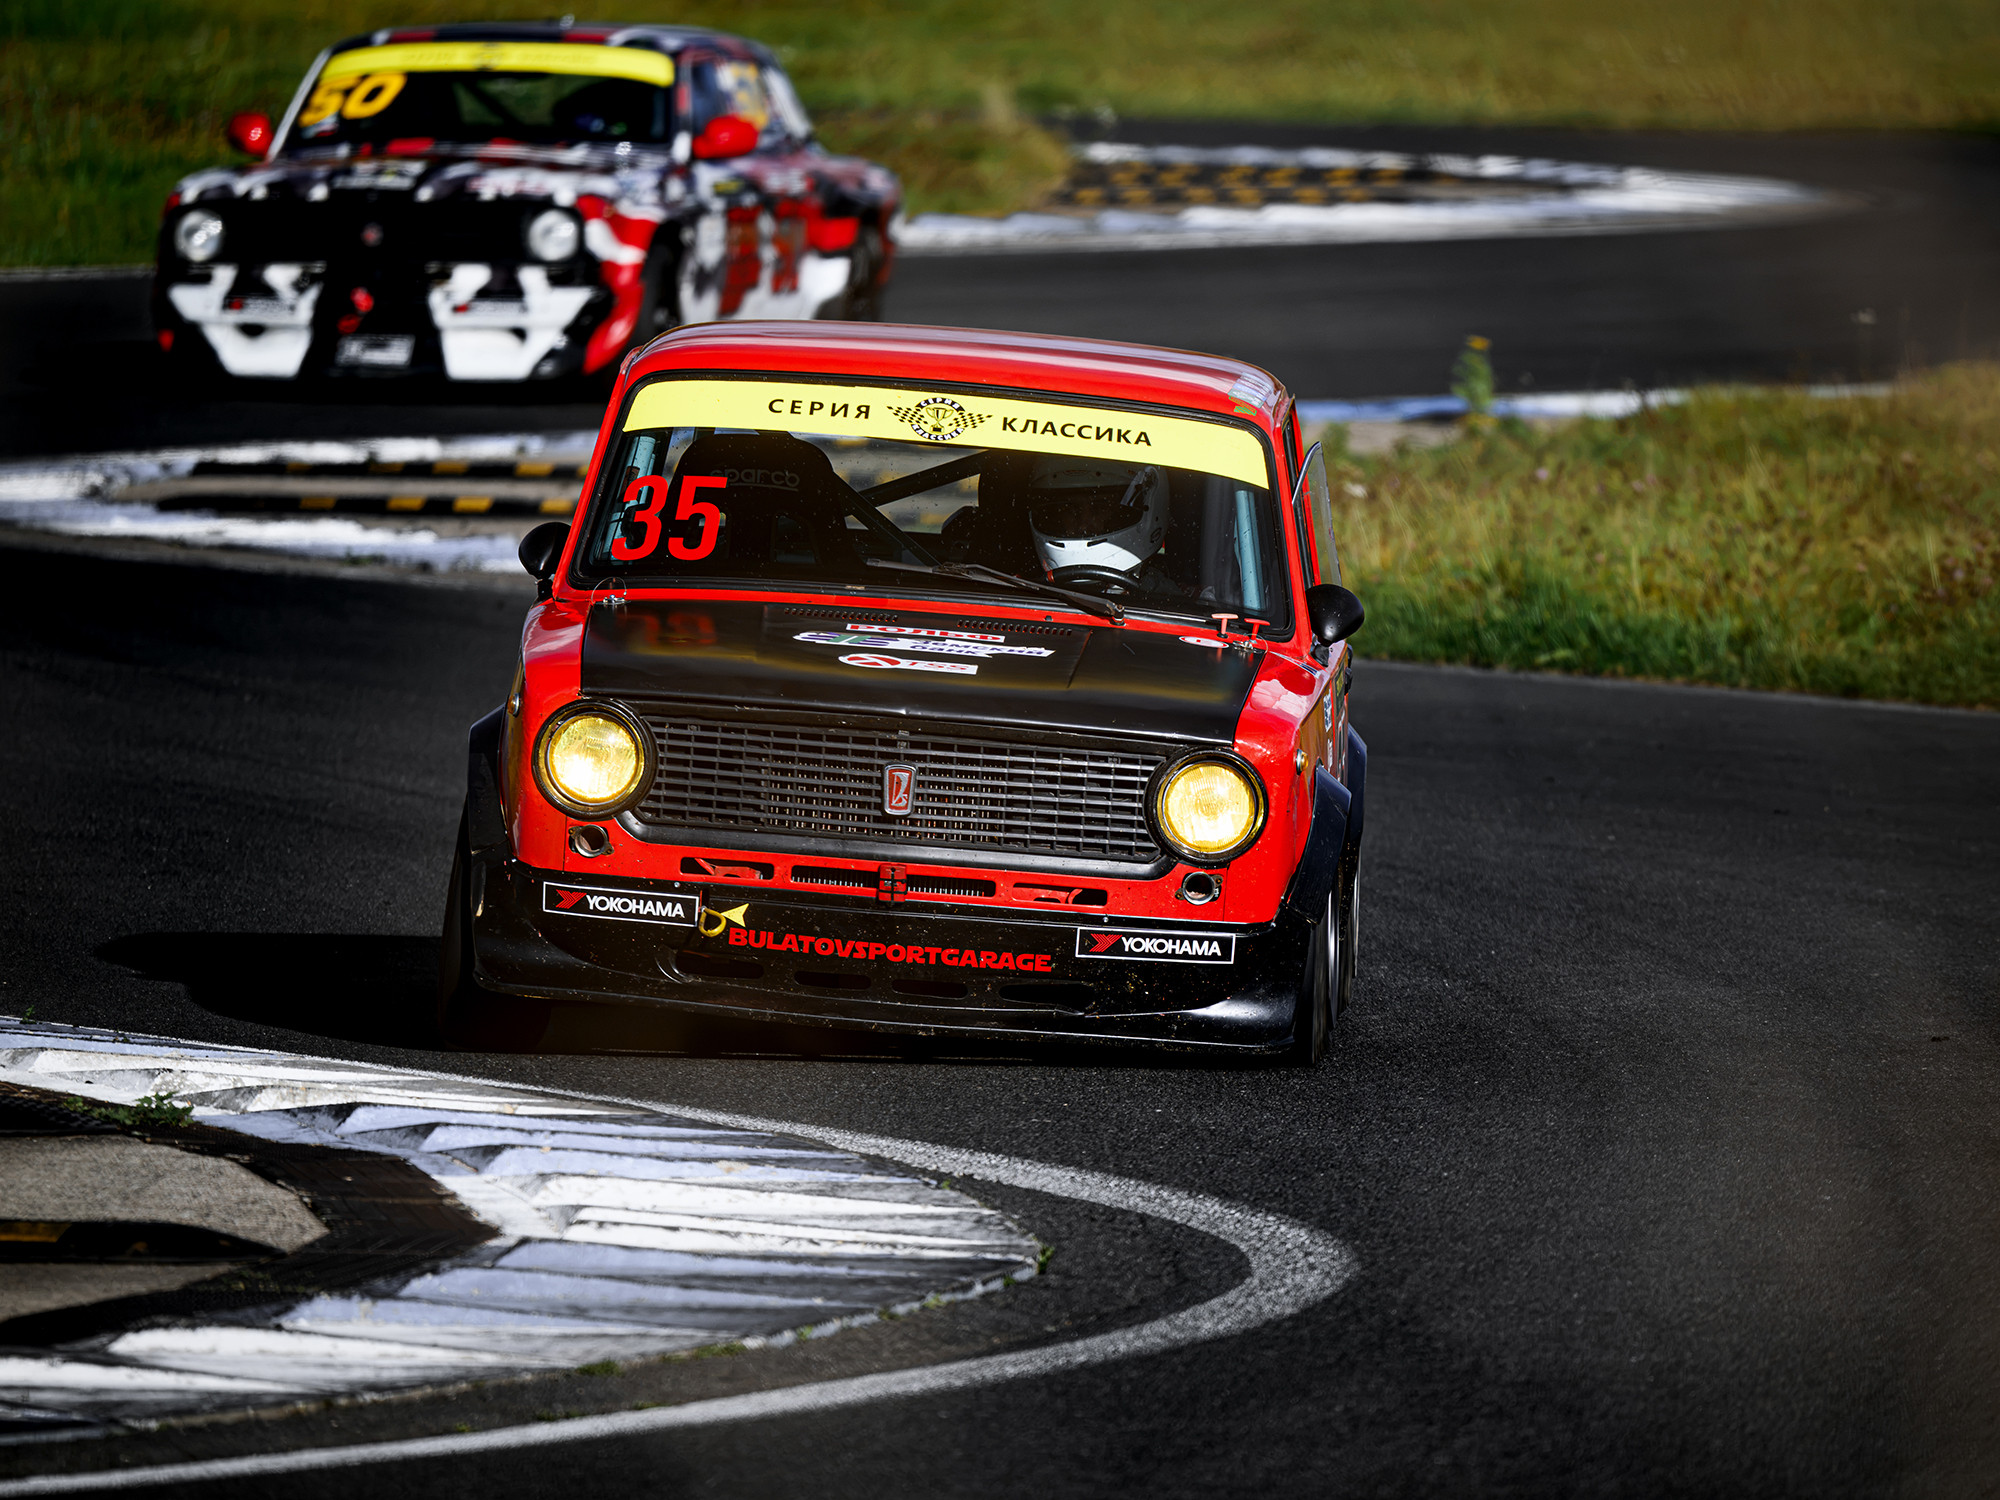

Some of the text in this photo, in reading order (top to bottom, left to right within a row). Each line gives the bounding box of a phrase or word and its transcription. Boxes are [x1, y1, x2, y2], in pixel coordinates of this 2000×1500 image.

[299, 72, 407, 127] 50
[919, 397, 961, 409] СЕРИЯ
[768, 399, 1152, 446] СЕРИЯ КЛАССИКА
[911, 424, 964, 440] КЛАССИКА
[611, 475, 728, 561] 35
[851, 625, 1001, 641] РОЛЬФ
[586, 894, 686, 918] YOKOHAMA
[728, 927, 1053, 972] BULATOVSPORTGARAGE
[1121, 936, 1222, 956] YOKOHAMA
